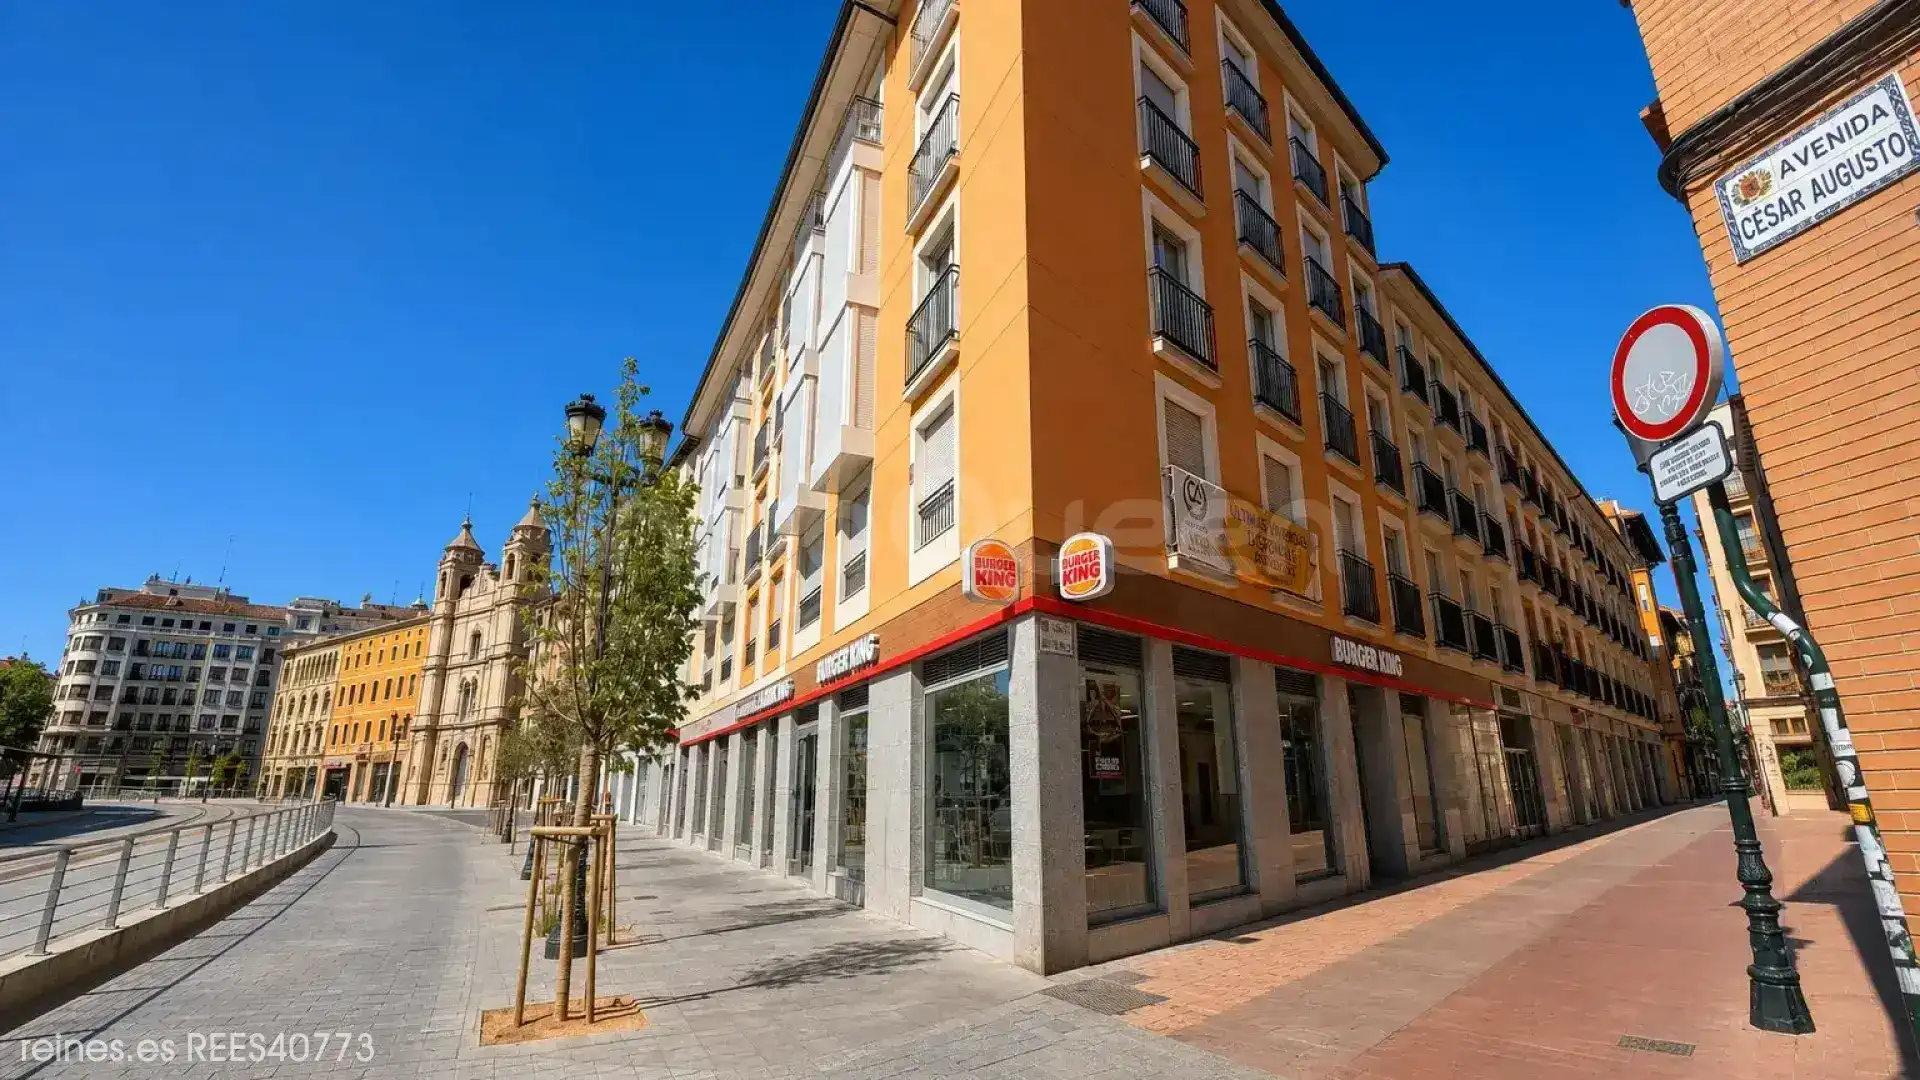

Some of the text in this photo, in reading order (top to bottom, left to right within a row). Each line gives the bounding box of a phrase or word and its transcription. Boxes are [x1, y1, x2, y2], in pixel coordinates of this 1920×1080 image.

[1780, 103, 1889, 180] AVENIDA
[1741, 132, 1905, 240] CÉSAR AUGUSTO
[975, 557, 1015, 571] BURGER
[1062, 549, 1100, 569] BURGER
[1062, 563, 1101, 586] KING
[975, 571, 1016, 588] KING
[816, 634, 880, 683] BURGER KING
[1331, 636, 1402, 677] BURGER KING
